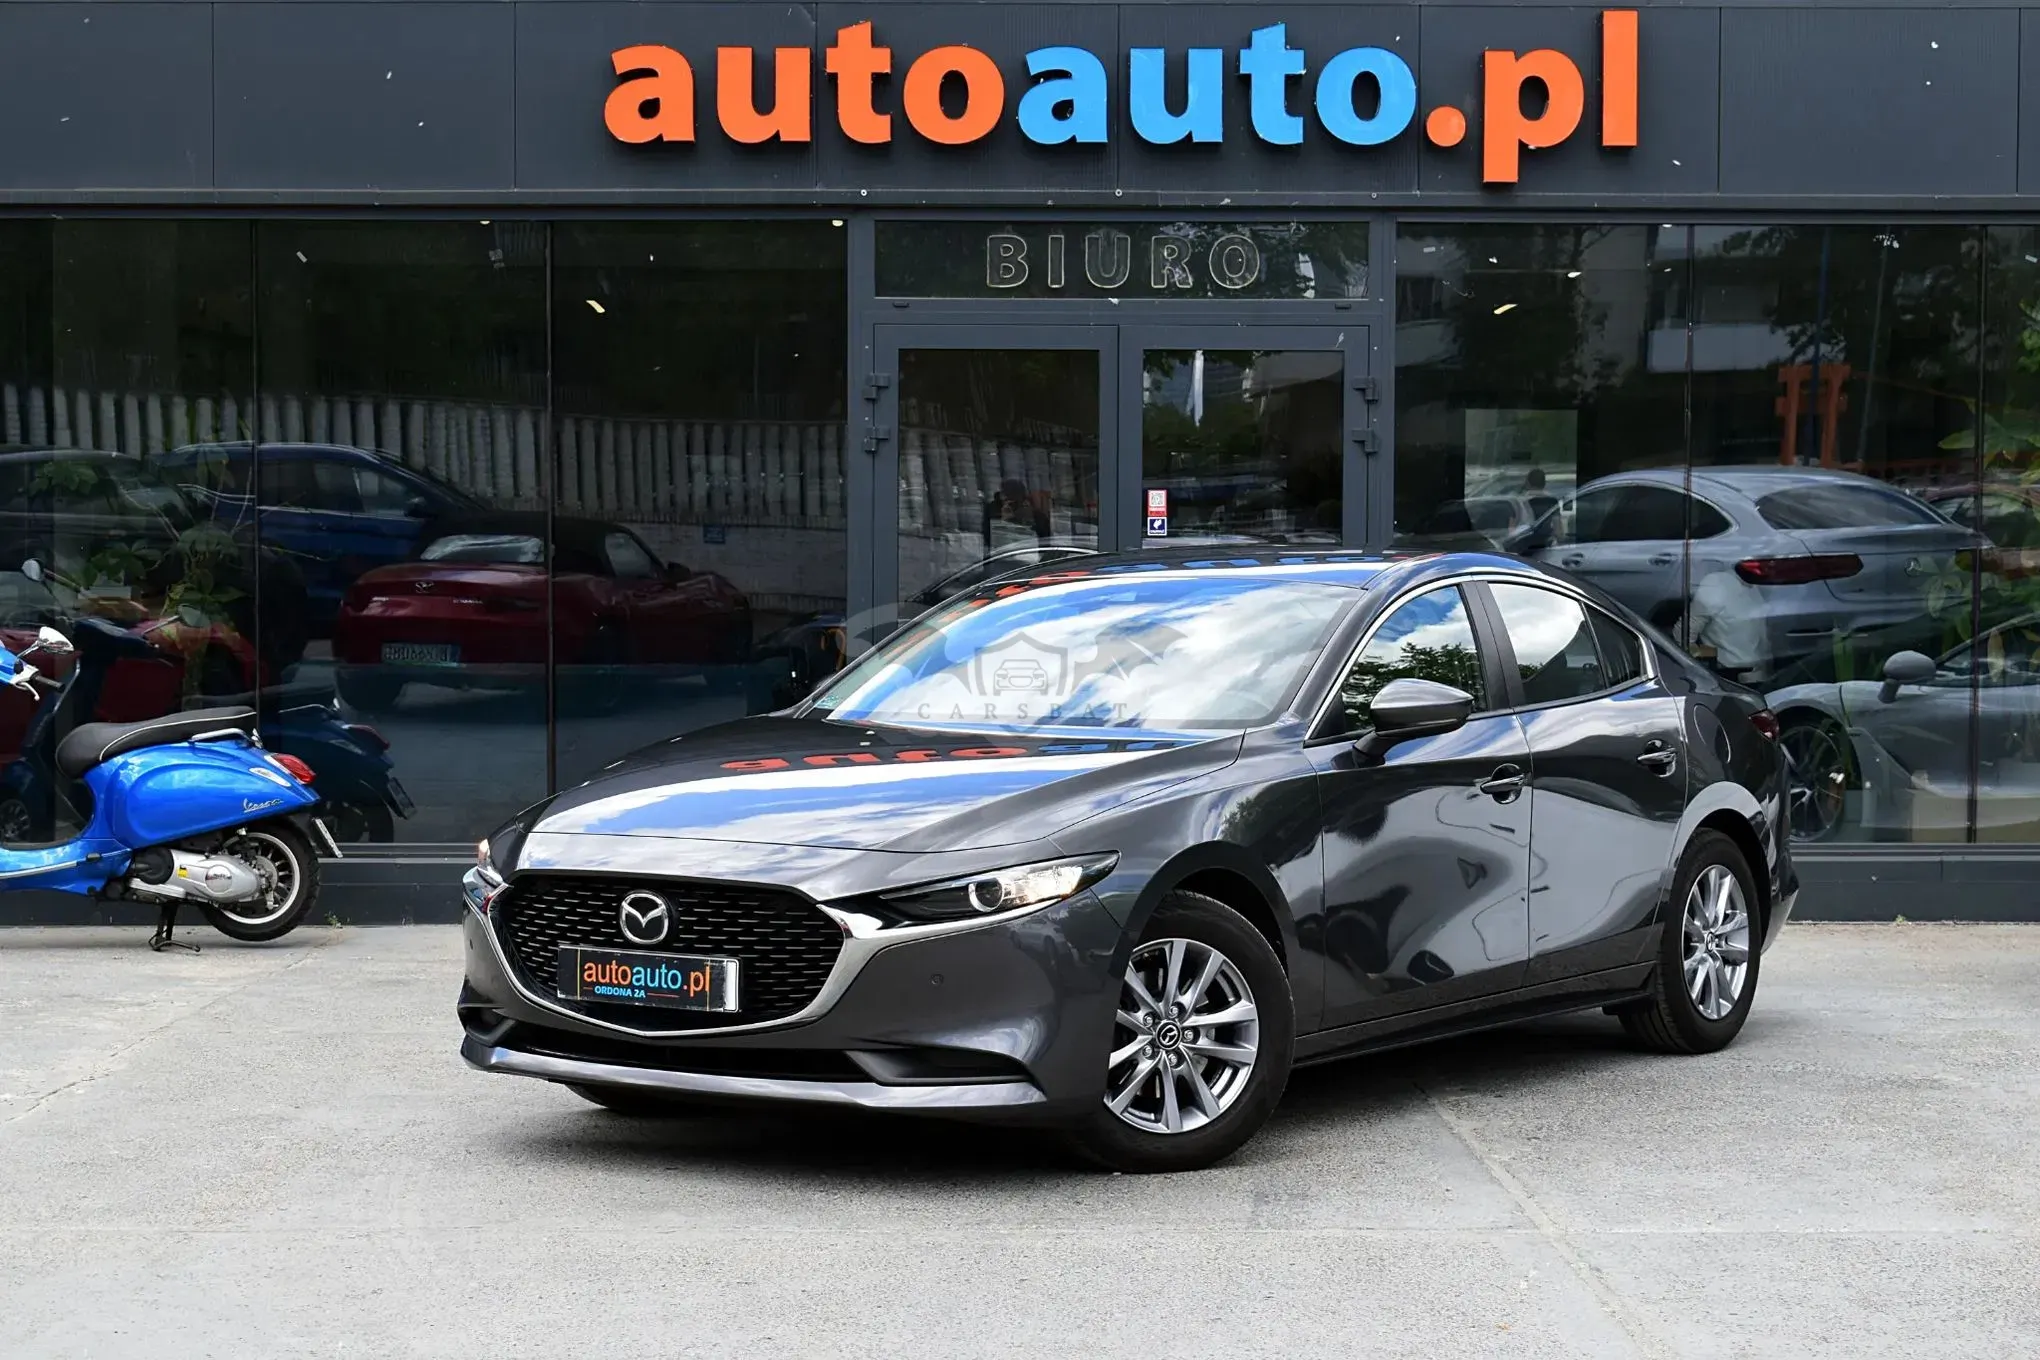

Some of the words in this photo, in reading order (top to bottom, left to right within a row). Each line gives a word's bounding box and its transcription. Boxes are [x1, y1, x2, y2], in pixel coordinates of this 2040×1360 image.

[604, 10, 1638, 183] autoauto.pl
[986, 234, 1260, 289] BIURO
[583, 960, 710, 998] autoauto.pl
[594, 985, 632, 998] ORDONA
